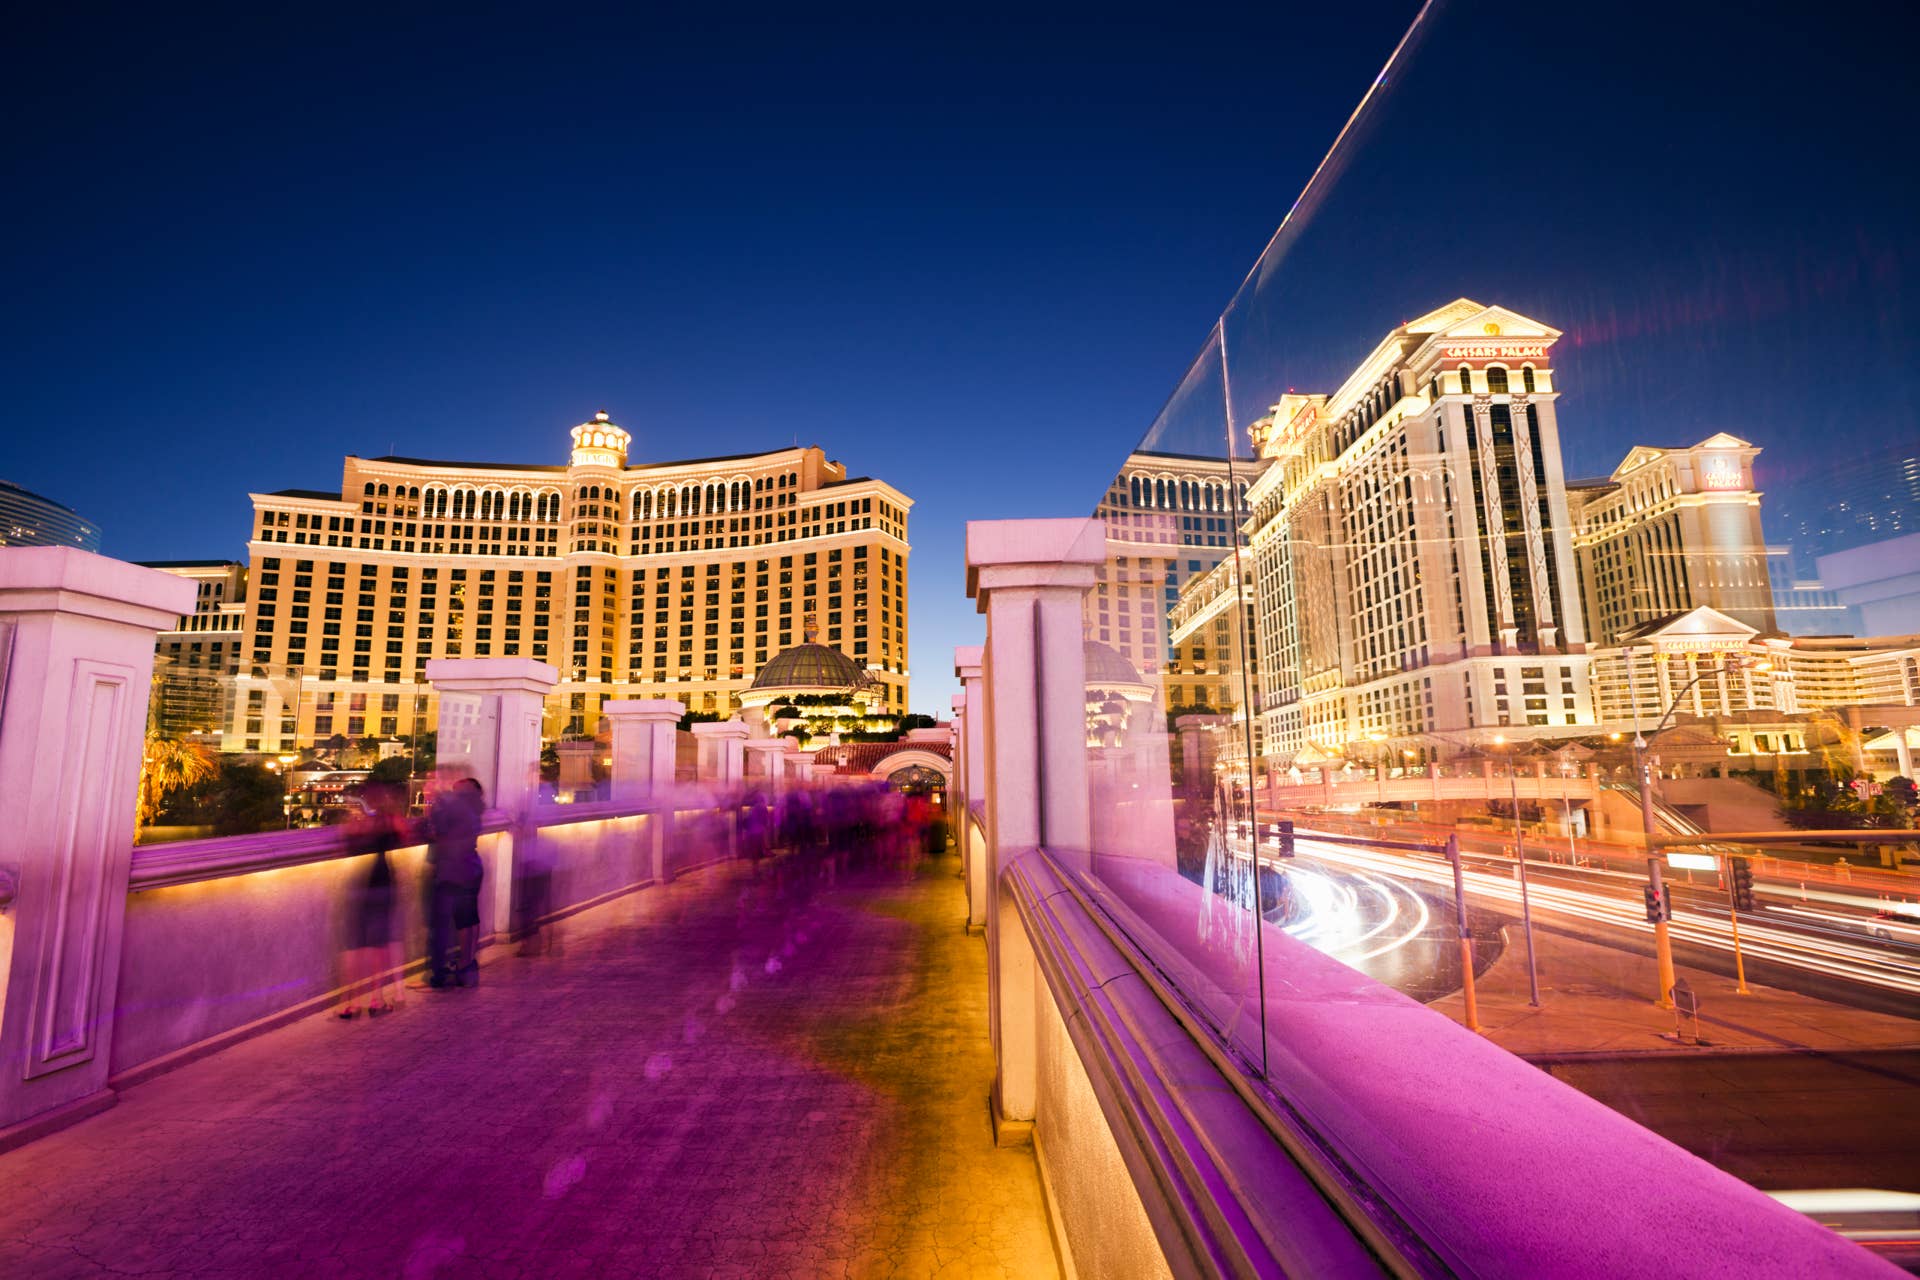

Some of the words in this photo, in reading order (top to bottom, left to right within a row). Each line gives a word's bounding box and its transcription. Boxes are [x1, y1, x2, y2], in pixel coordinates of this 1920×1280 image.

[1447, 347, 1497, 357] CAESARS
[1501, 346, 1544, 357] PALACE
[1711, 640, 1744, 649] PALACE
